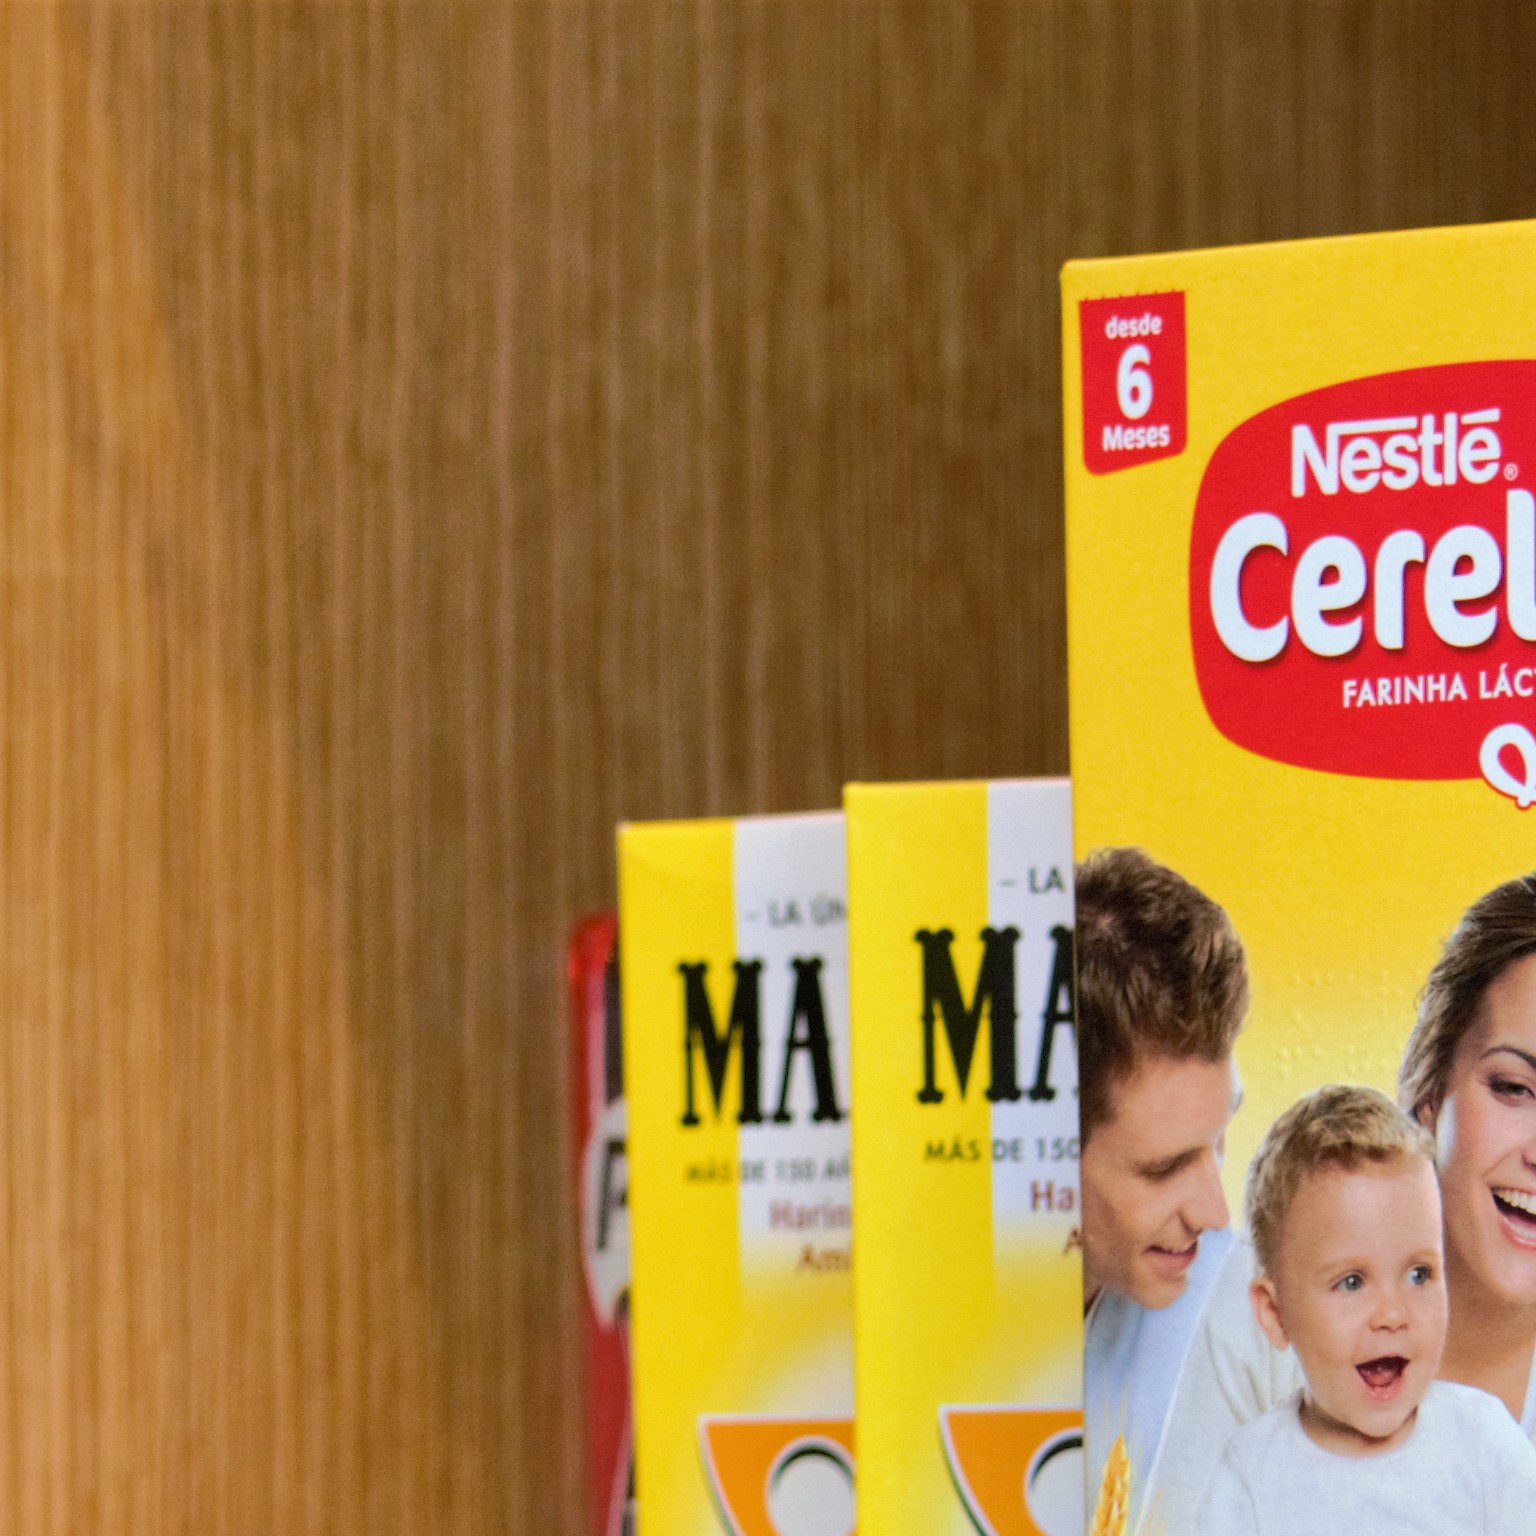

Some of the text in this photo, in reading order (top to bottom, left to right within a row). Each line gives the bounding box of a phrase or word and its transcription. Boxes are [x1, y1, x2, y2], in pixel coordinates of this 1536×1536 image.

[1105, 312, 1162, 339] desde
[1117, 343, 1153, 420] 6
[1103, 424, 1171, 451] Meses
[1291, 407, 1501, 499] Nestlé
[1342, 672, 1468, 708] FARINHA
[1029, 866, 1063, 893] LA
[677, 956, 851, 1127] MA
[924, 1136, 981, 1163] MÁS
[992, 1139, 1022, 1162] DE
